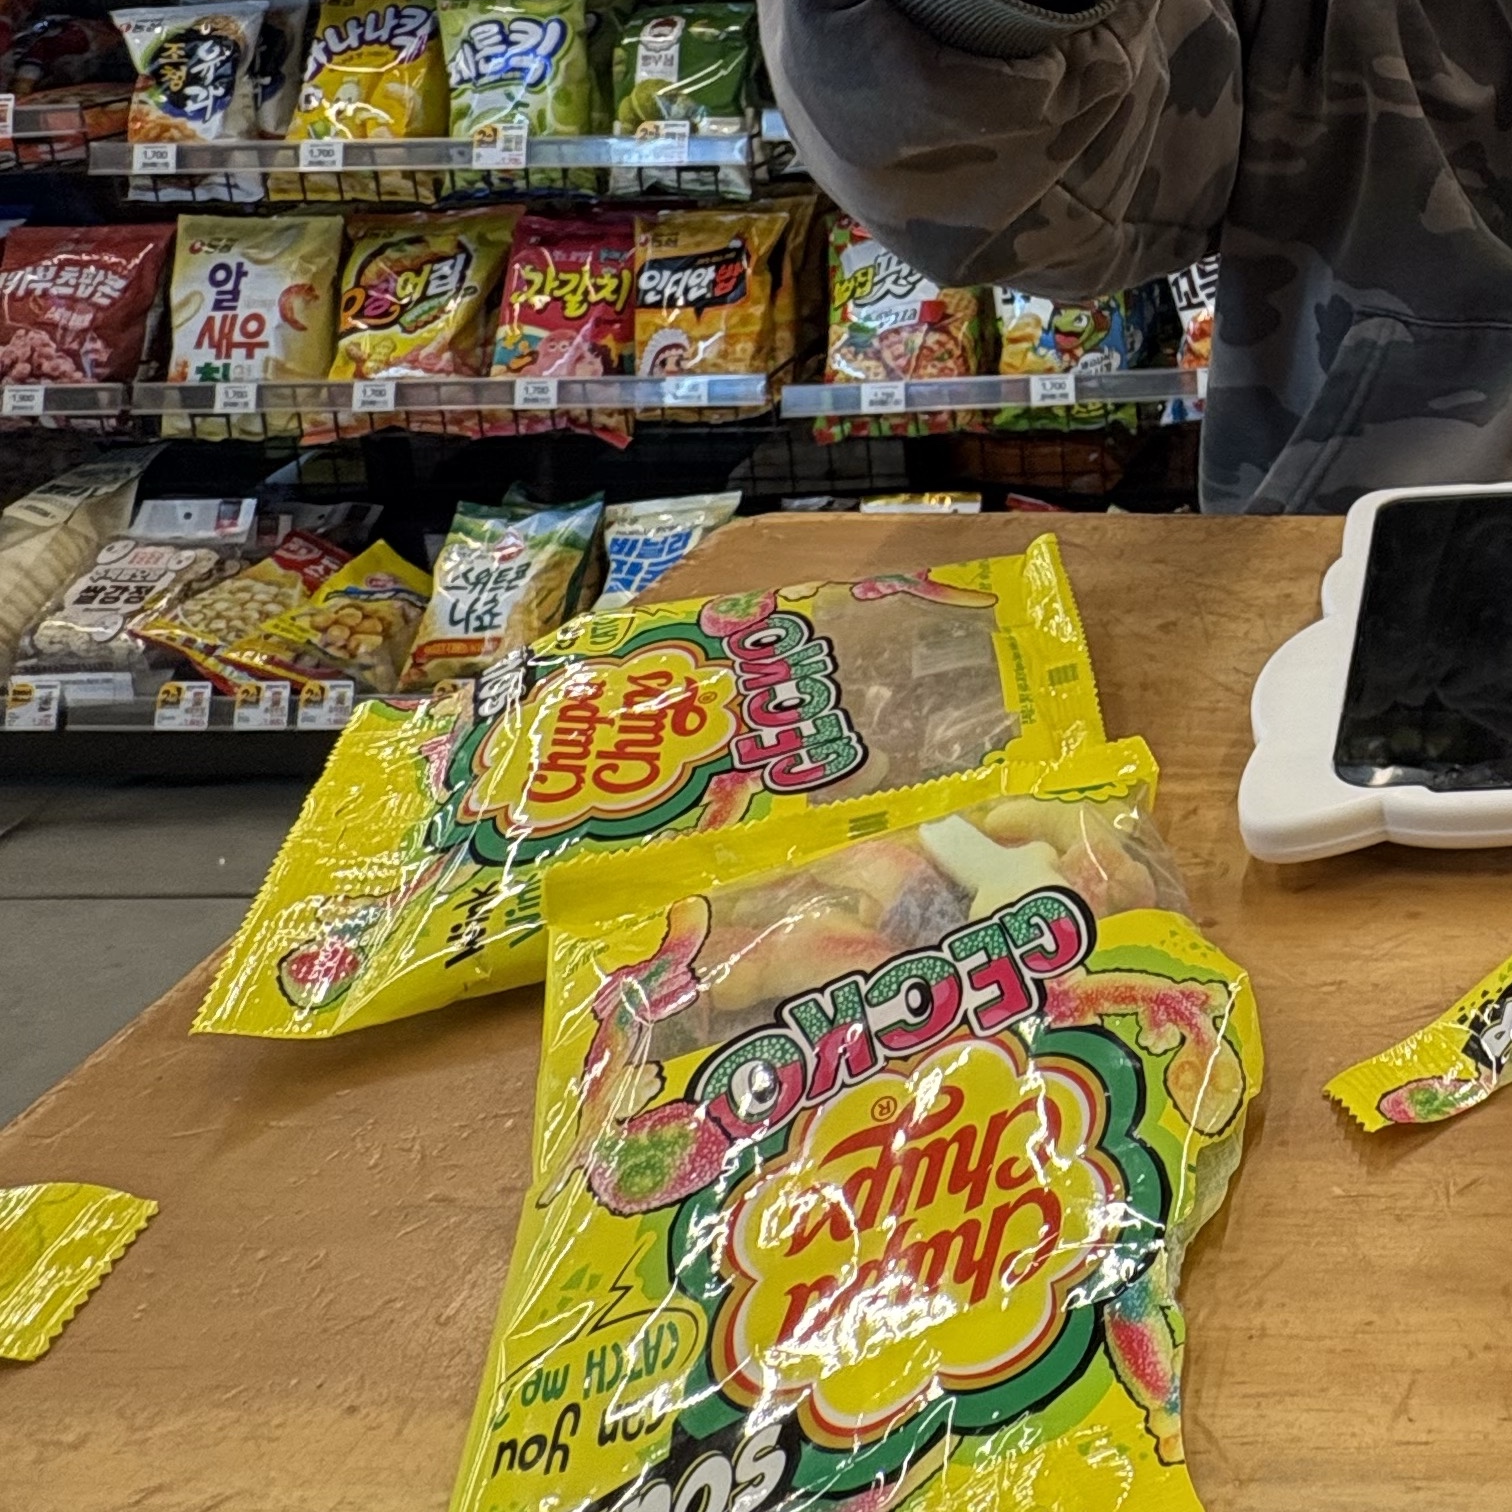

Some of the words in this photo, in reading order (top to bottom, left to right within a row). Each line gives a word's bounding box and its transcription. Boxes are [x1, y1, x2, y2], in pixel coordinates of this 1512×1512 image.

[143, 149, 169, 161] 1,700
[308, 147, 335, 159] 1,700
[208, 261, 250, 313] 알
[510, 264, 634, 319] 자갈치
[193, 312, 271, 361] 새우
[725, 612, 869, 793] GECKO
[590, 668, 709, 795] Chups
[693, 888, 1096, 1145] GECKO
[490, 1402, 582, 1479] you
